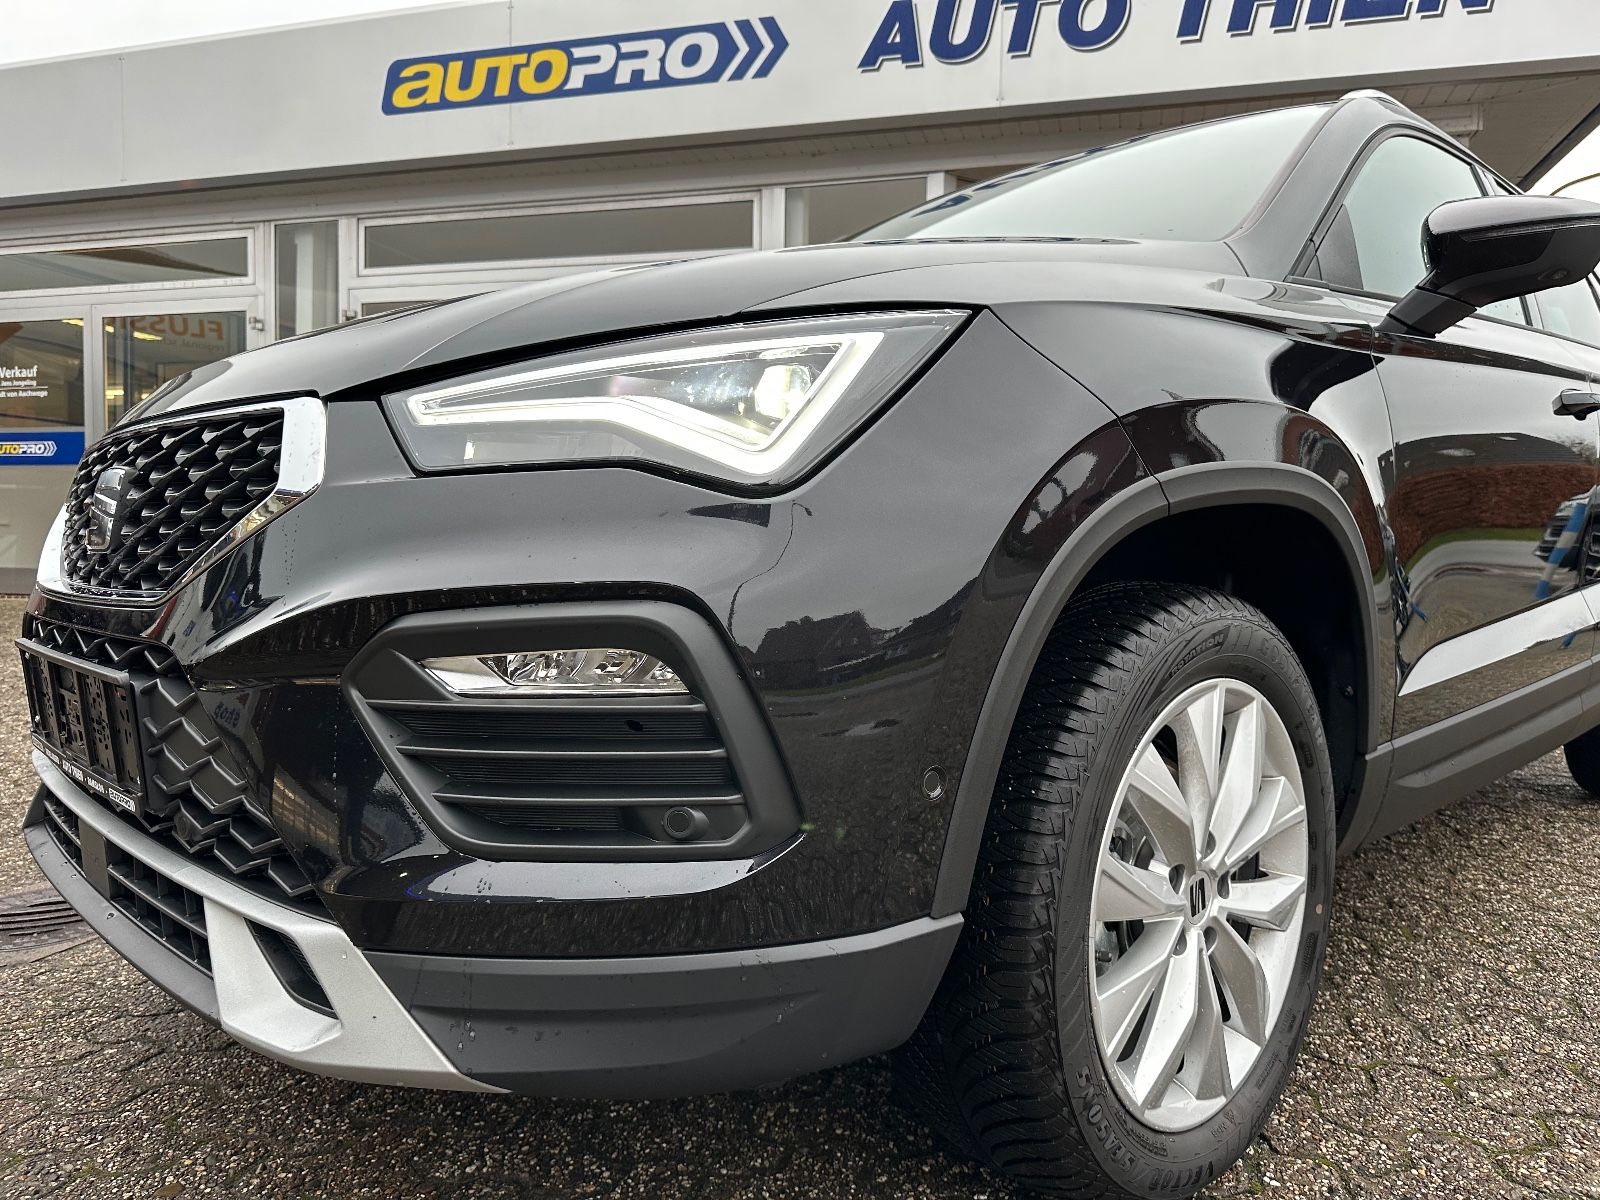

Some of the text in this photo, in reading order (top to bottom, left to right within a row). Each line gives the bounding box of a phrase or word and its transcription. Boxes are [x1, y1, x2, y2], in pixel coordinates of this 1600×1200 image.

[857, 0, 1131, 72] AUTO
[0, 365, 38, 378] Verkauf
[1170, 633, 1225, 677] ROTATION
